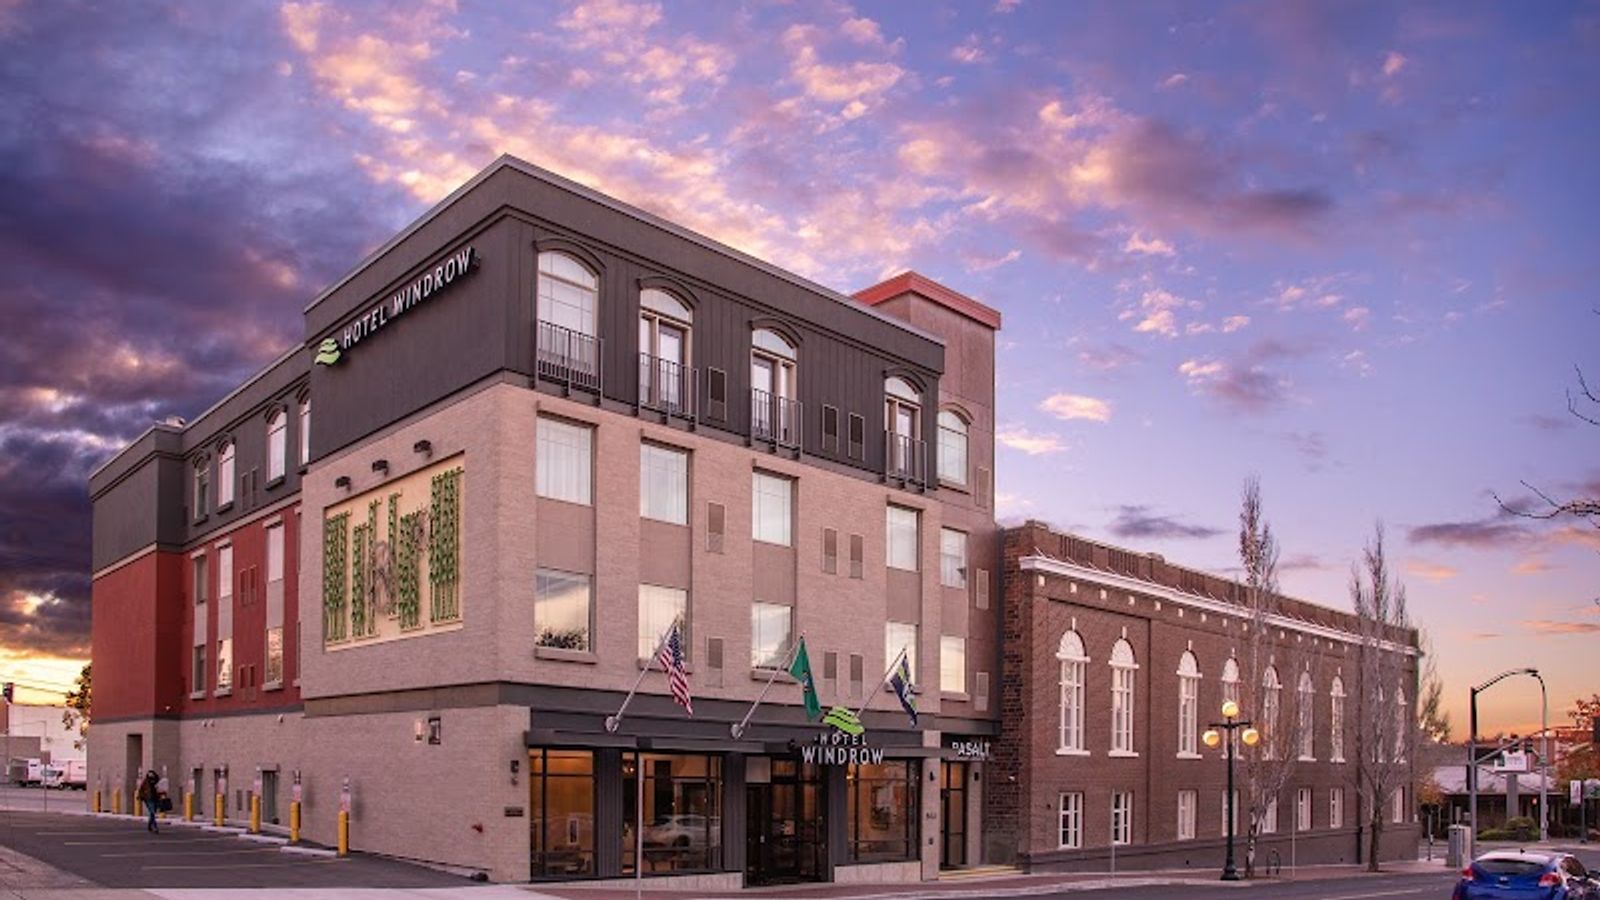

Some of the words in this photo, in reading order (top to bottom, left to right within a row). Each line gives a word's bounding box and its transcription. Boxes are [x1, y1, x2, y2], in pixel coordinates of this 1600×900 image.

[343, 306, 387, 349] HOTEL
[391, 247, 473, 318] WINDROW
[820, 732, 867, 746] HOTEL
[801, 746, 884, 765] WINDROW
